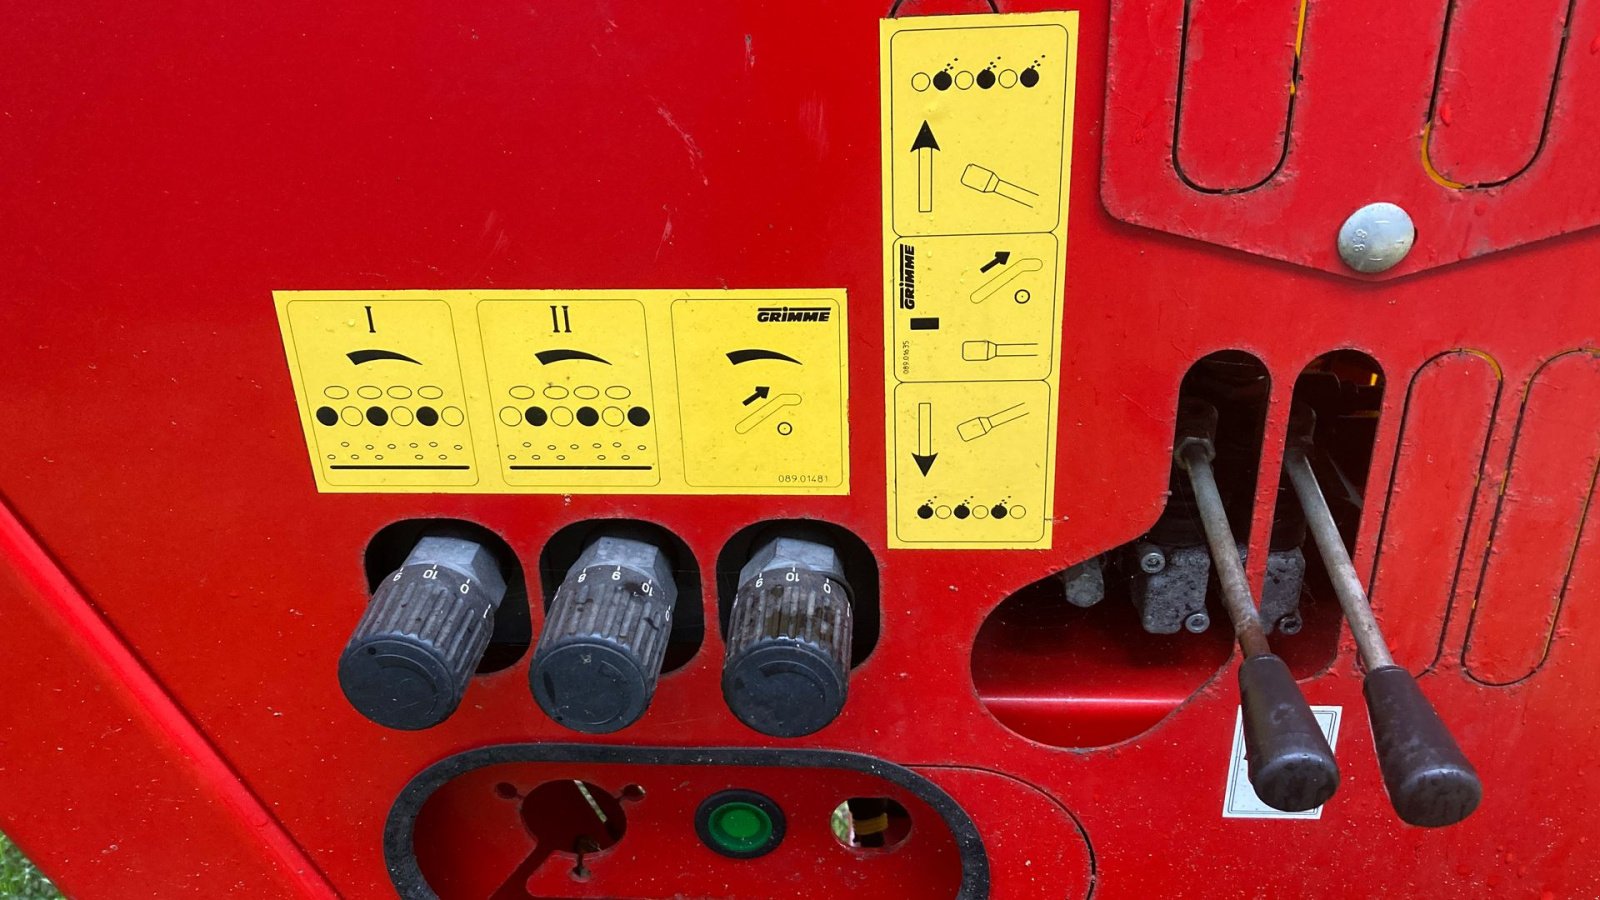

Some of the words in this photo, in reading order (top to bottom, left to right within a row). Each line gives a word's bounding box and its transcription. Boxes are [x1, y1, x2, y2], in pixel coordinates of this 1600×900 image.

[364, 305, 377, 333] I
[549, 305, 572, 333] II
[778, 474, 828, 483] 089.01481
[422, 569, 438, 580] 10
[785, 572, 800, 582] 10
[641, 582, 653, 597] 10
